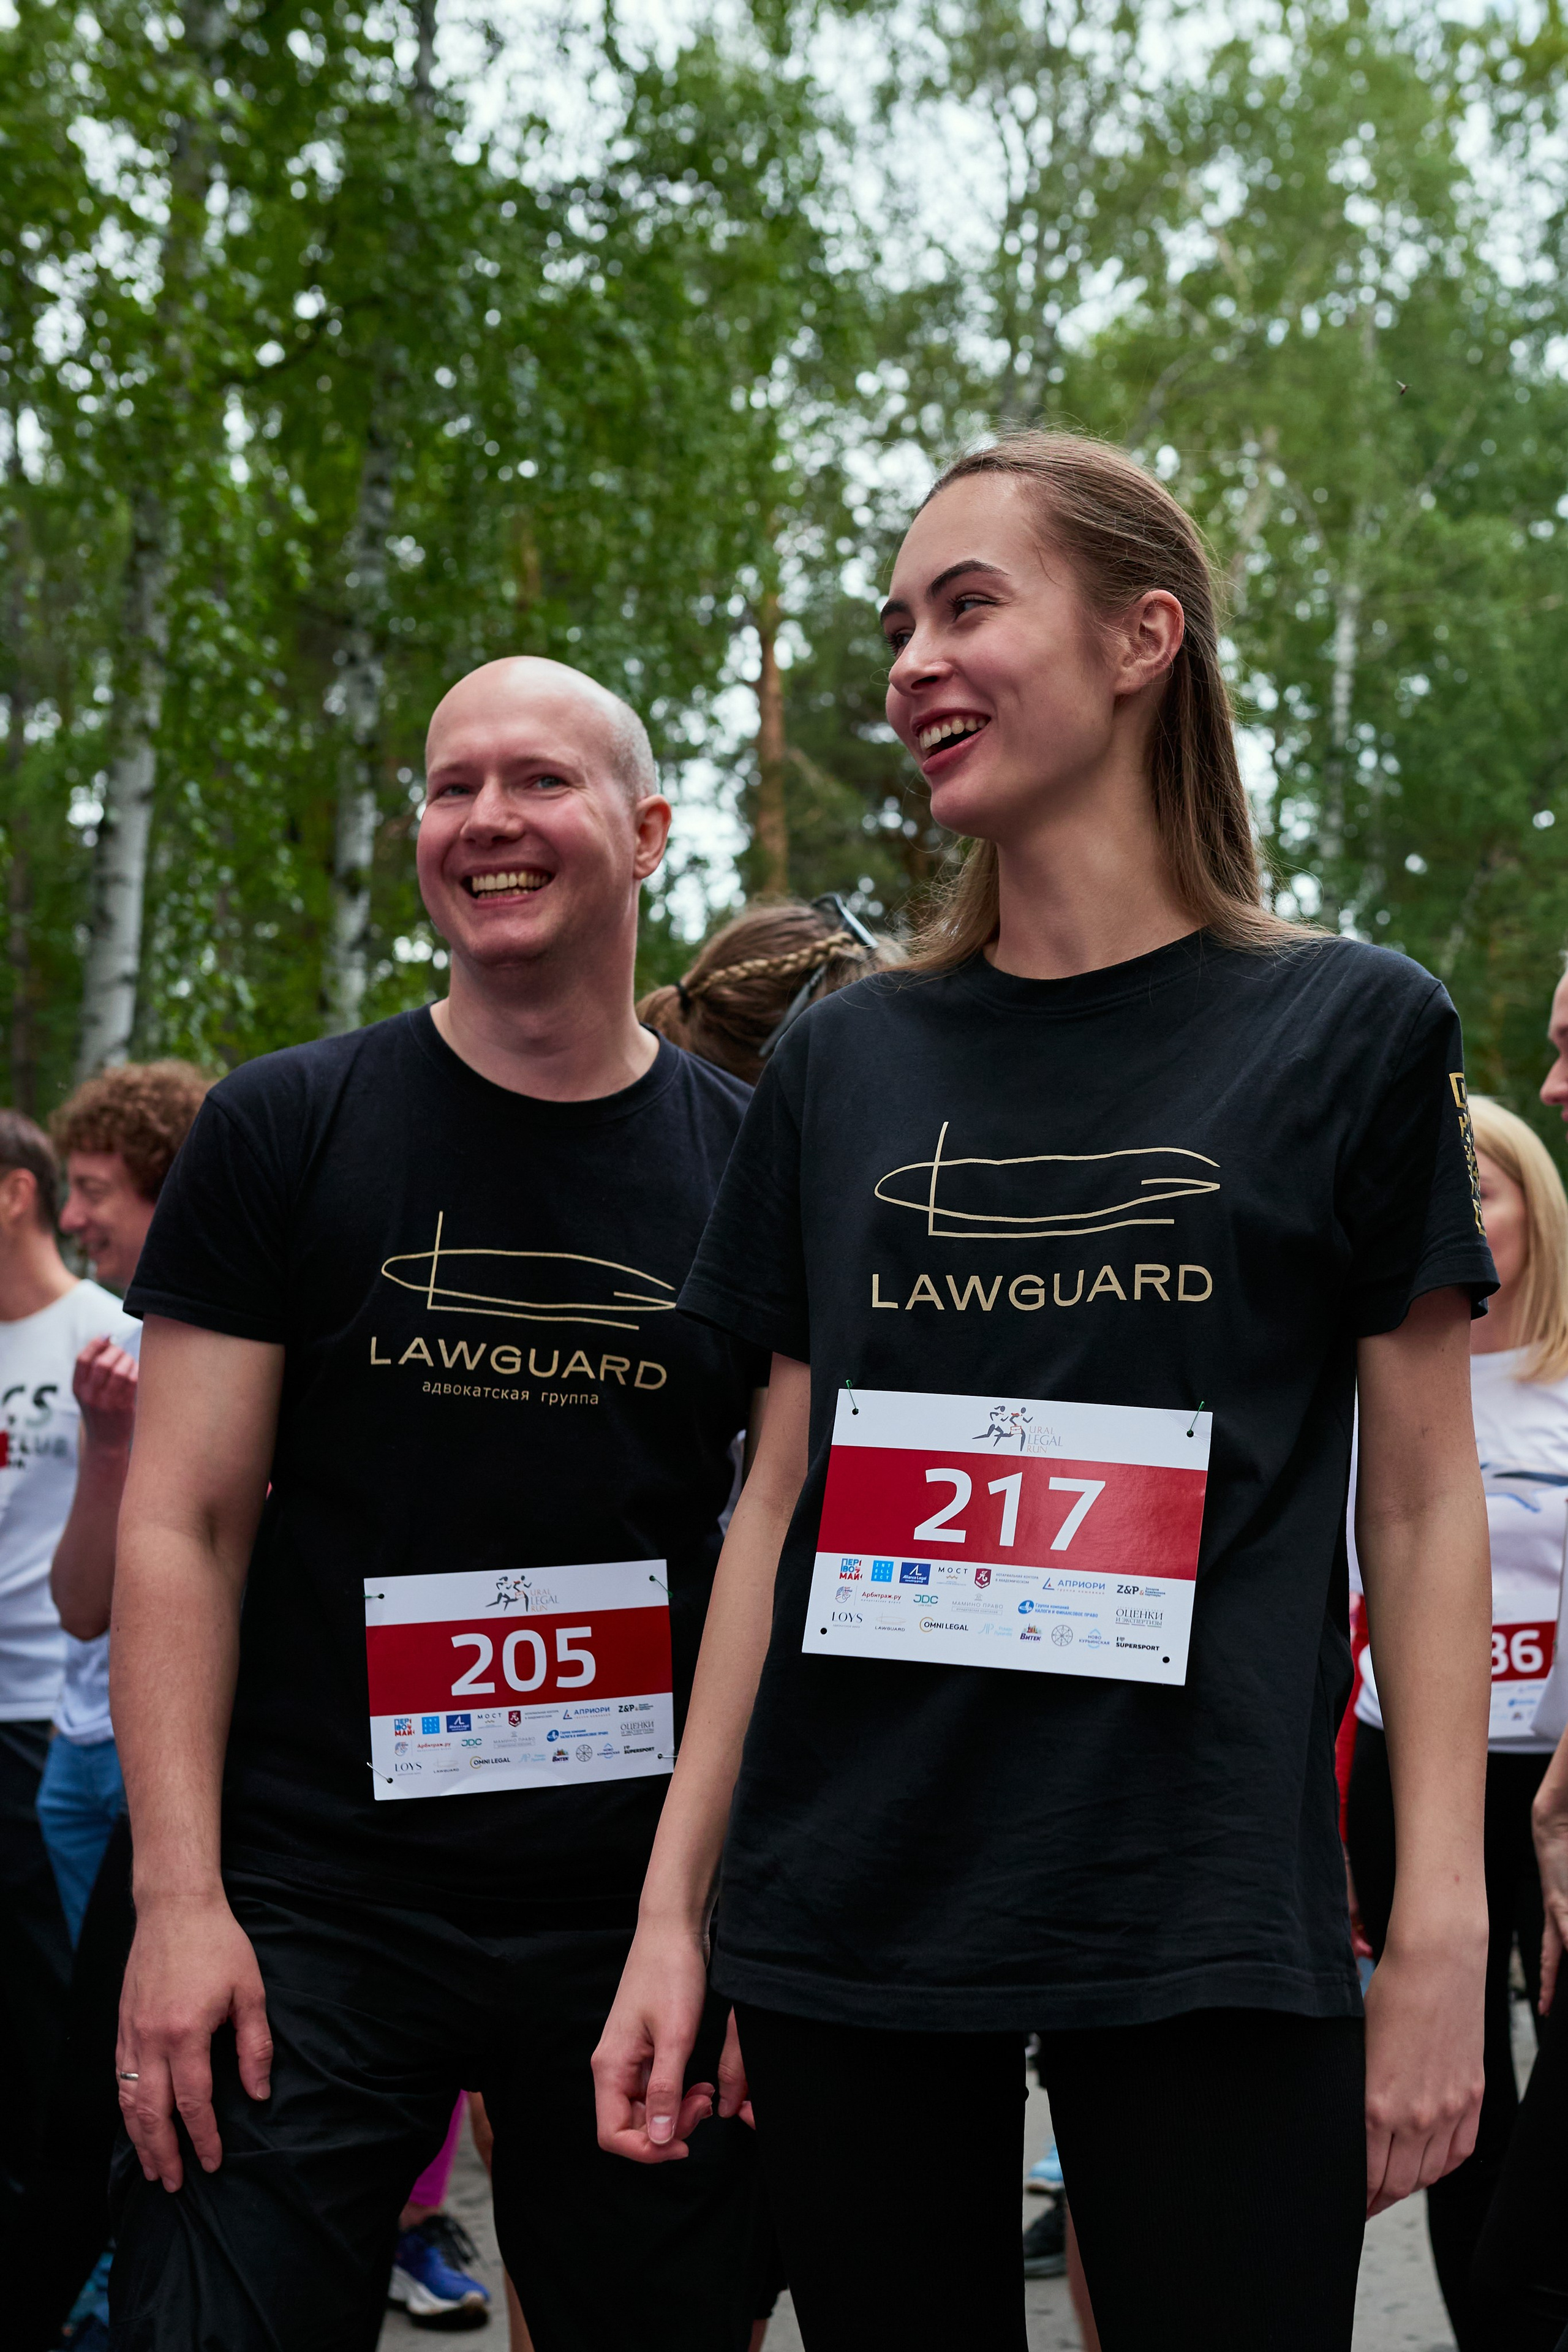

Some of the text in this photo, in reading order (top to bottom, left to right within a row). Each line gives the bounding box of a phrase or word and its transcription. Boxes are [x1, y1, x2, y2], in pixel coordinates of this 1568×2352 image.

[872, 1264, 1213, 1311] LAWGUARD
[370, 1336, 667, 1390] LAWGUARD
[422, 1381, 599, 1407] адвокатская группа
[1027, 1434, 1063, 1447] LEGAL
[913, 1468, 1106, 1550] 217
[1058, 1580, 1106, 1590] АПРИОРИ
[1117, 1585, 1139, 1595] Z&P
[862, 1591, 902, 1600] Арбитраж.ру
[832, 1611, 862, 1623] LOYS
[1116, 1608, 1163, 1620] ОЦЕНКИ
[1116, 1642, 1160, 1651] SUPERSPORT
[450, 1626, 597, 1697] 205
[574, 1706, 610, 1716] АПРИОРИ
